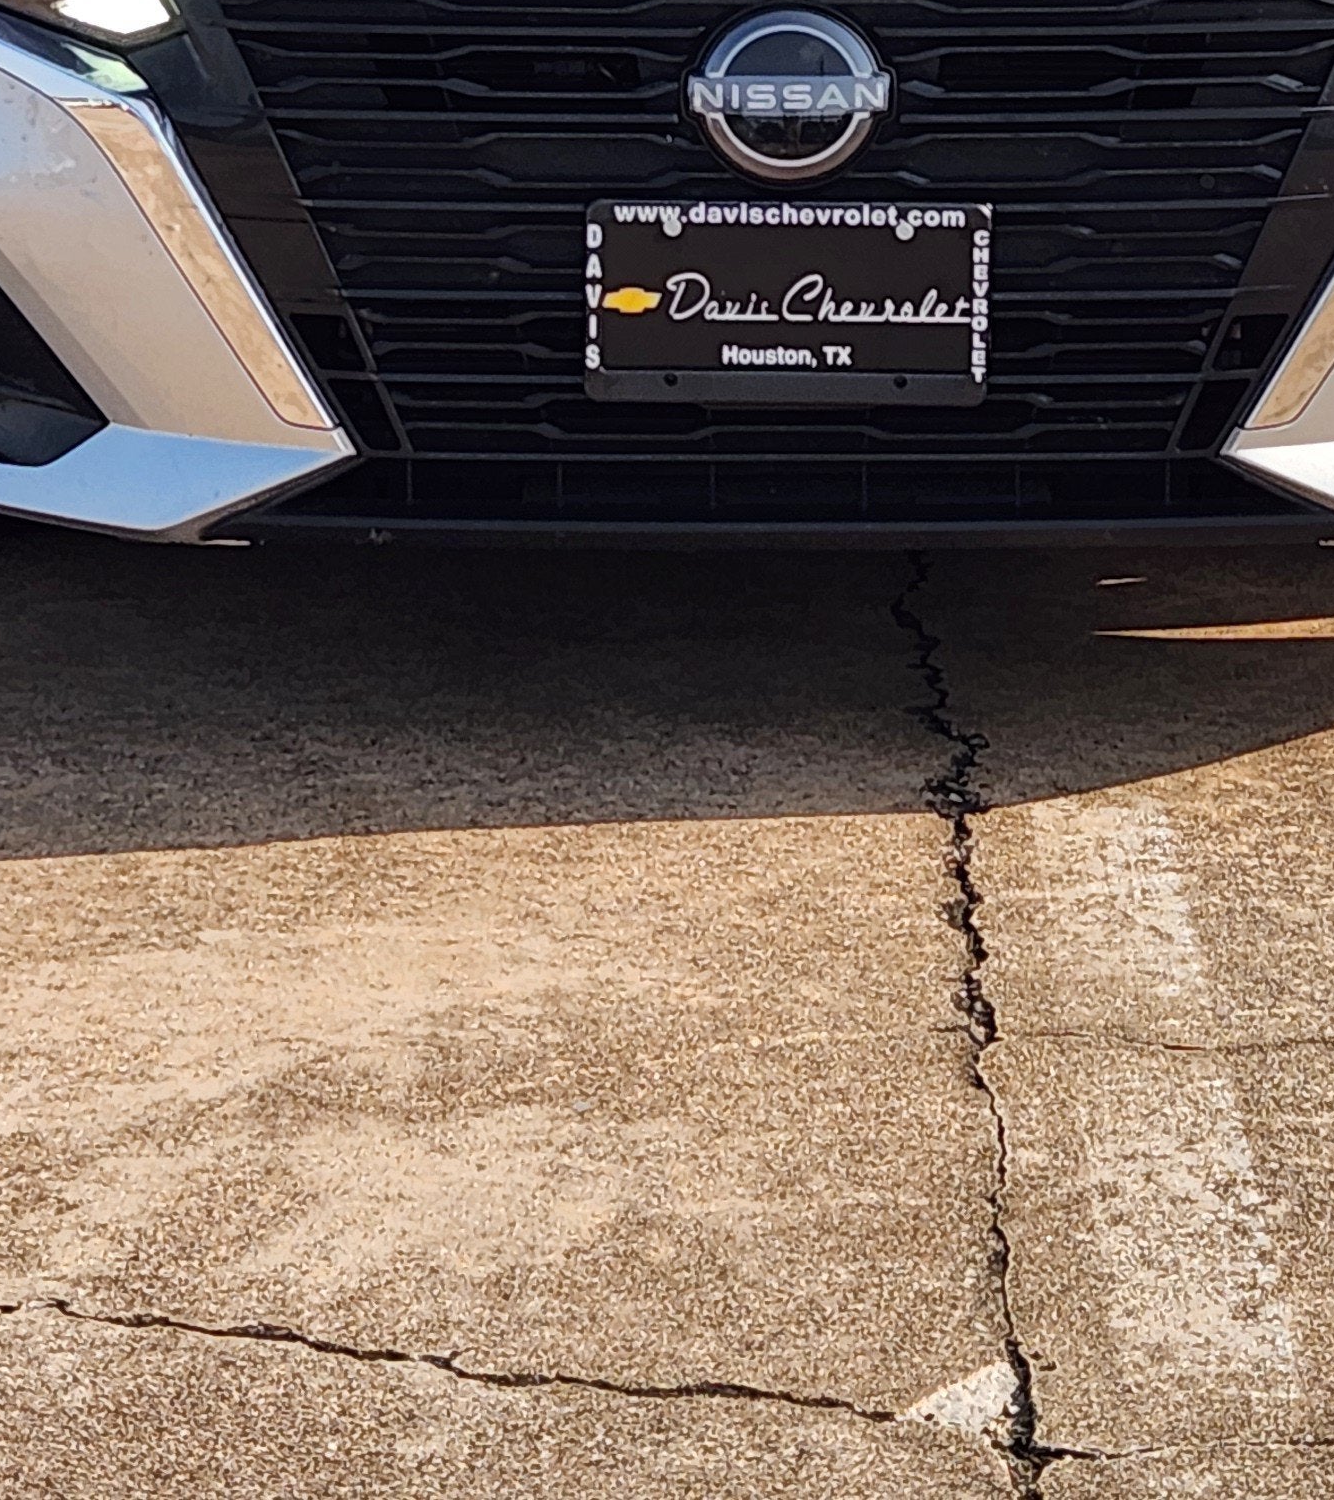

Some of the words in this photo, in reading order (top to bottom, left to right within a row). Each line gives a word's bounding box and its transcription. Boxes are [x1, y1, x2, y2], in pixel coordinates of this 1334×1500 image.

[692, 82, 884, 110] NISSAN
[614, 203, 966, 228] www.davischevrolet.com
[586, 223, 603, 369] DAVIS
[666, 272, 779, 321] Davis
[781, 274, 971, 324] Chevrolet
[971, 230, 990, 383] CHEVROLET
[722, 344, 818, 368] Houston,
[822, 346, 852, 367] TX
